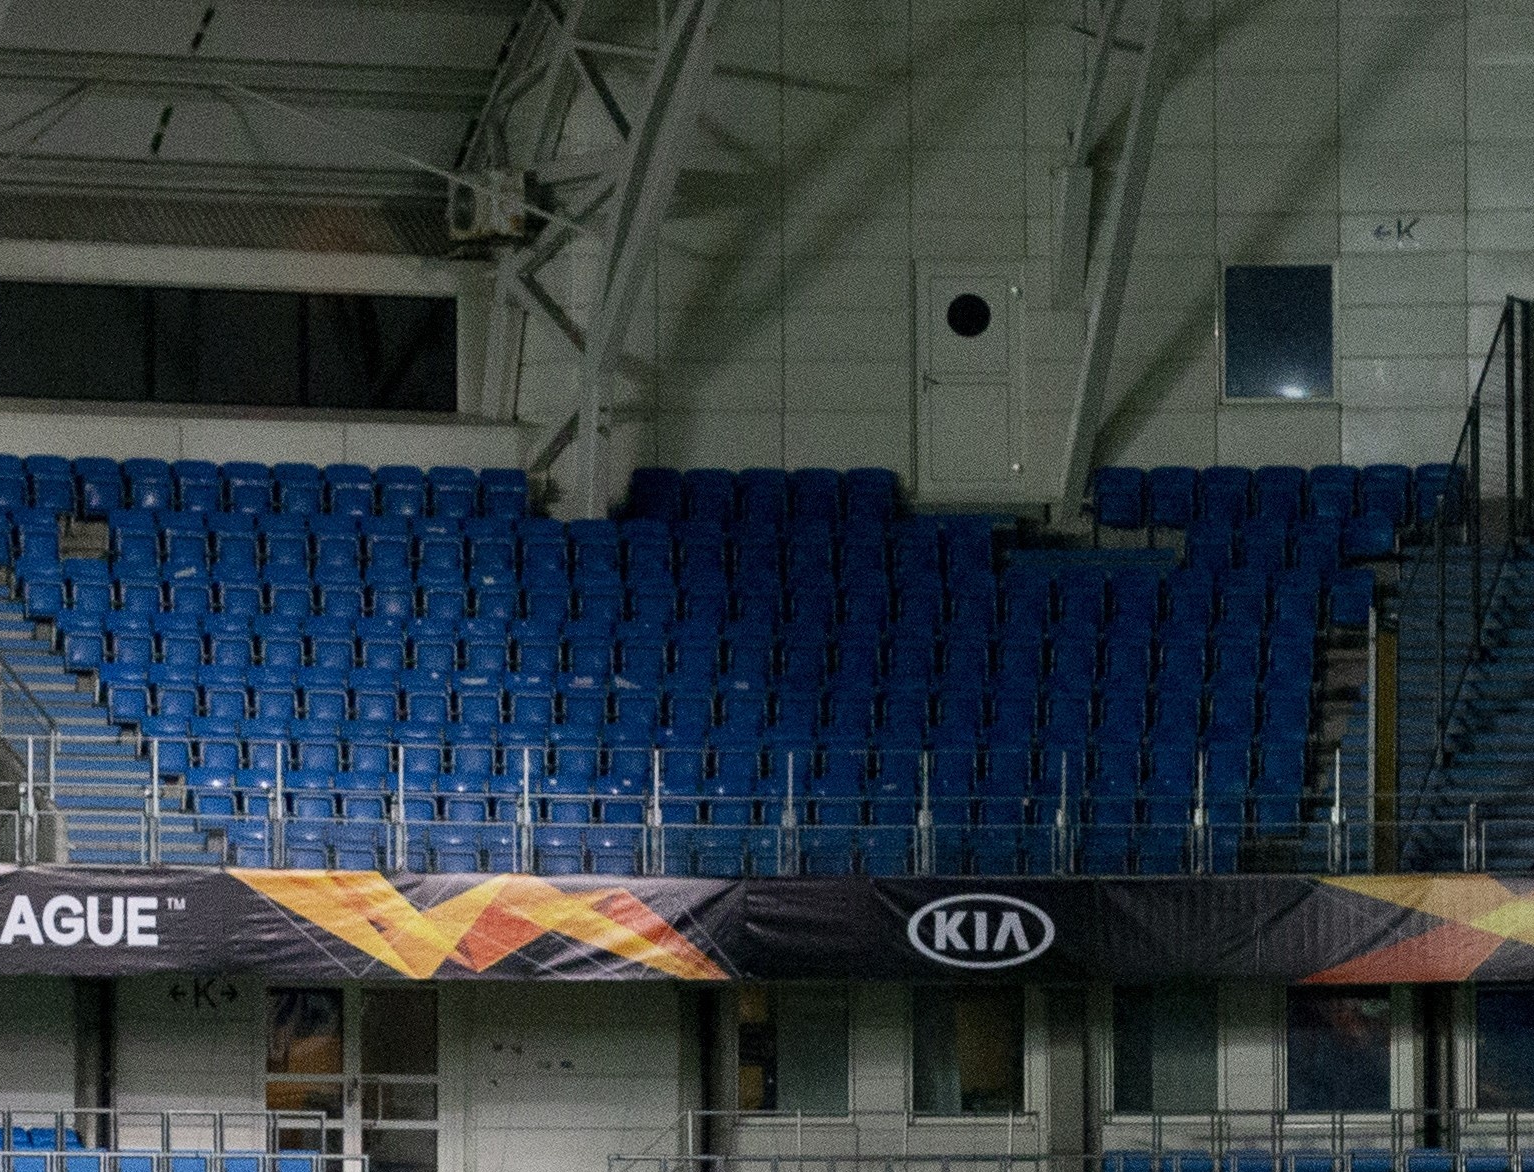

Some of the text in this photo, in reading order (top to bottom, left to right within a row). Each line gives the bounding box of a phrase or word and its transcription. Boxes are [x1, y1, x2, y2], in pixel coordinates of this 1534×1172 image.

[1396, 218, 1419, 240] K
[934, 911, 1032, 952] KIA
[193, 978, 216, 1008] K
